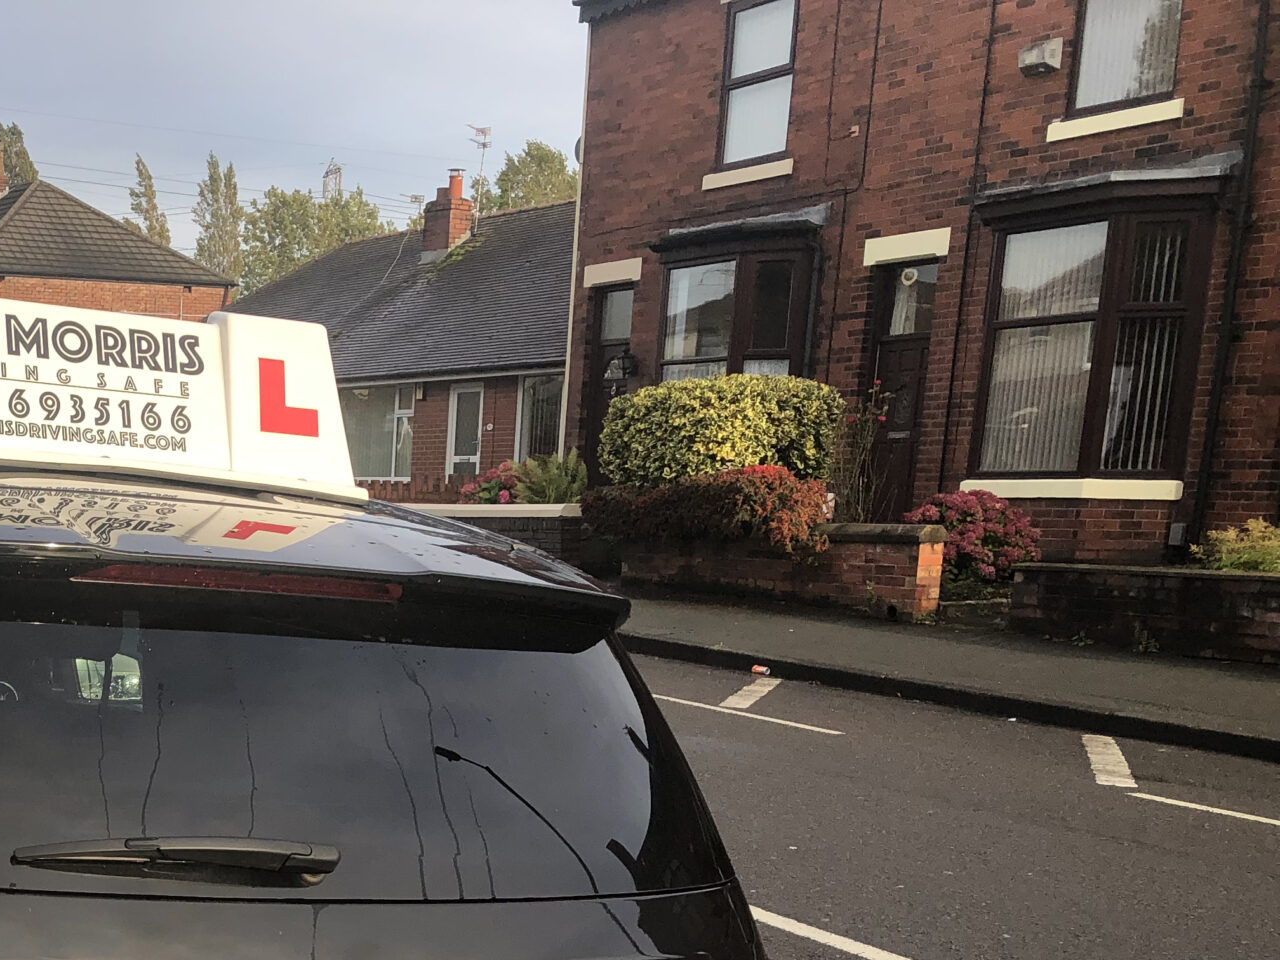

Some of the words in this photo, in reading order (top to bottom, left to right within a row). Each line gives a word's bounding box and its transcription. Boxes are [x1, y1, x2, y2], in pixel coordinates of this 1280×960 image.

[5, 314, 205, 376] MORRIS
[97, 372, 189, 397] SAFE
[258, 356, 320, 438] L
